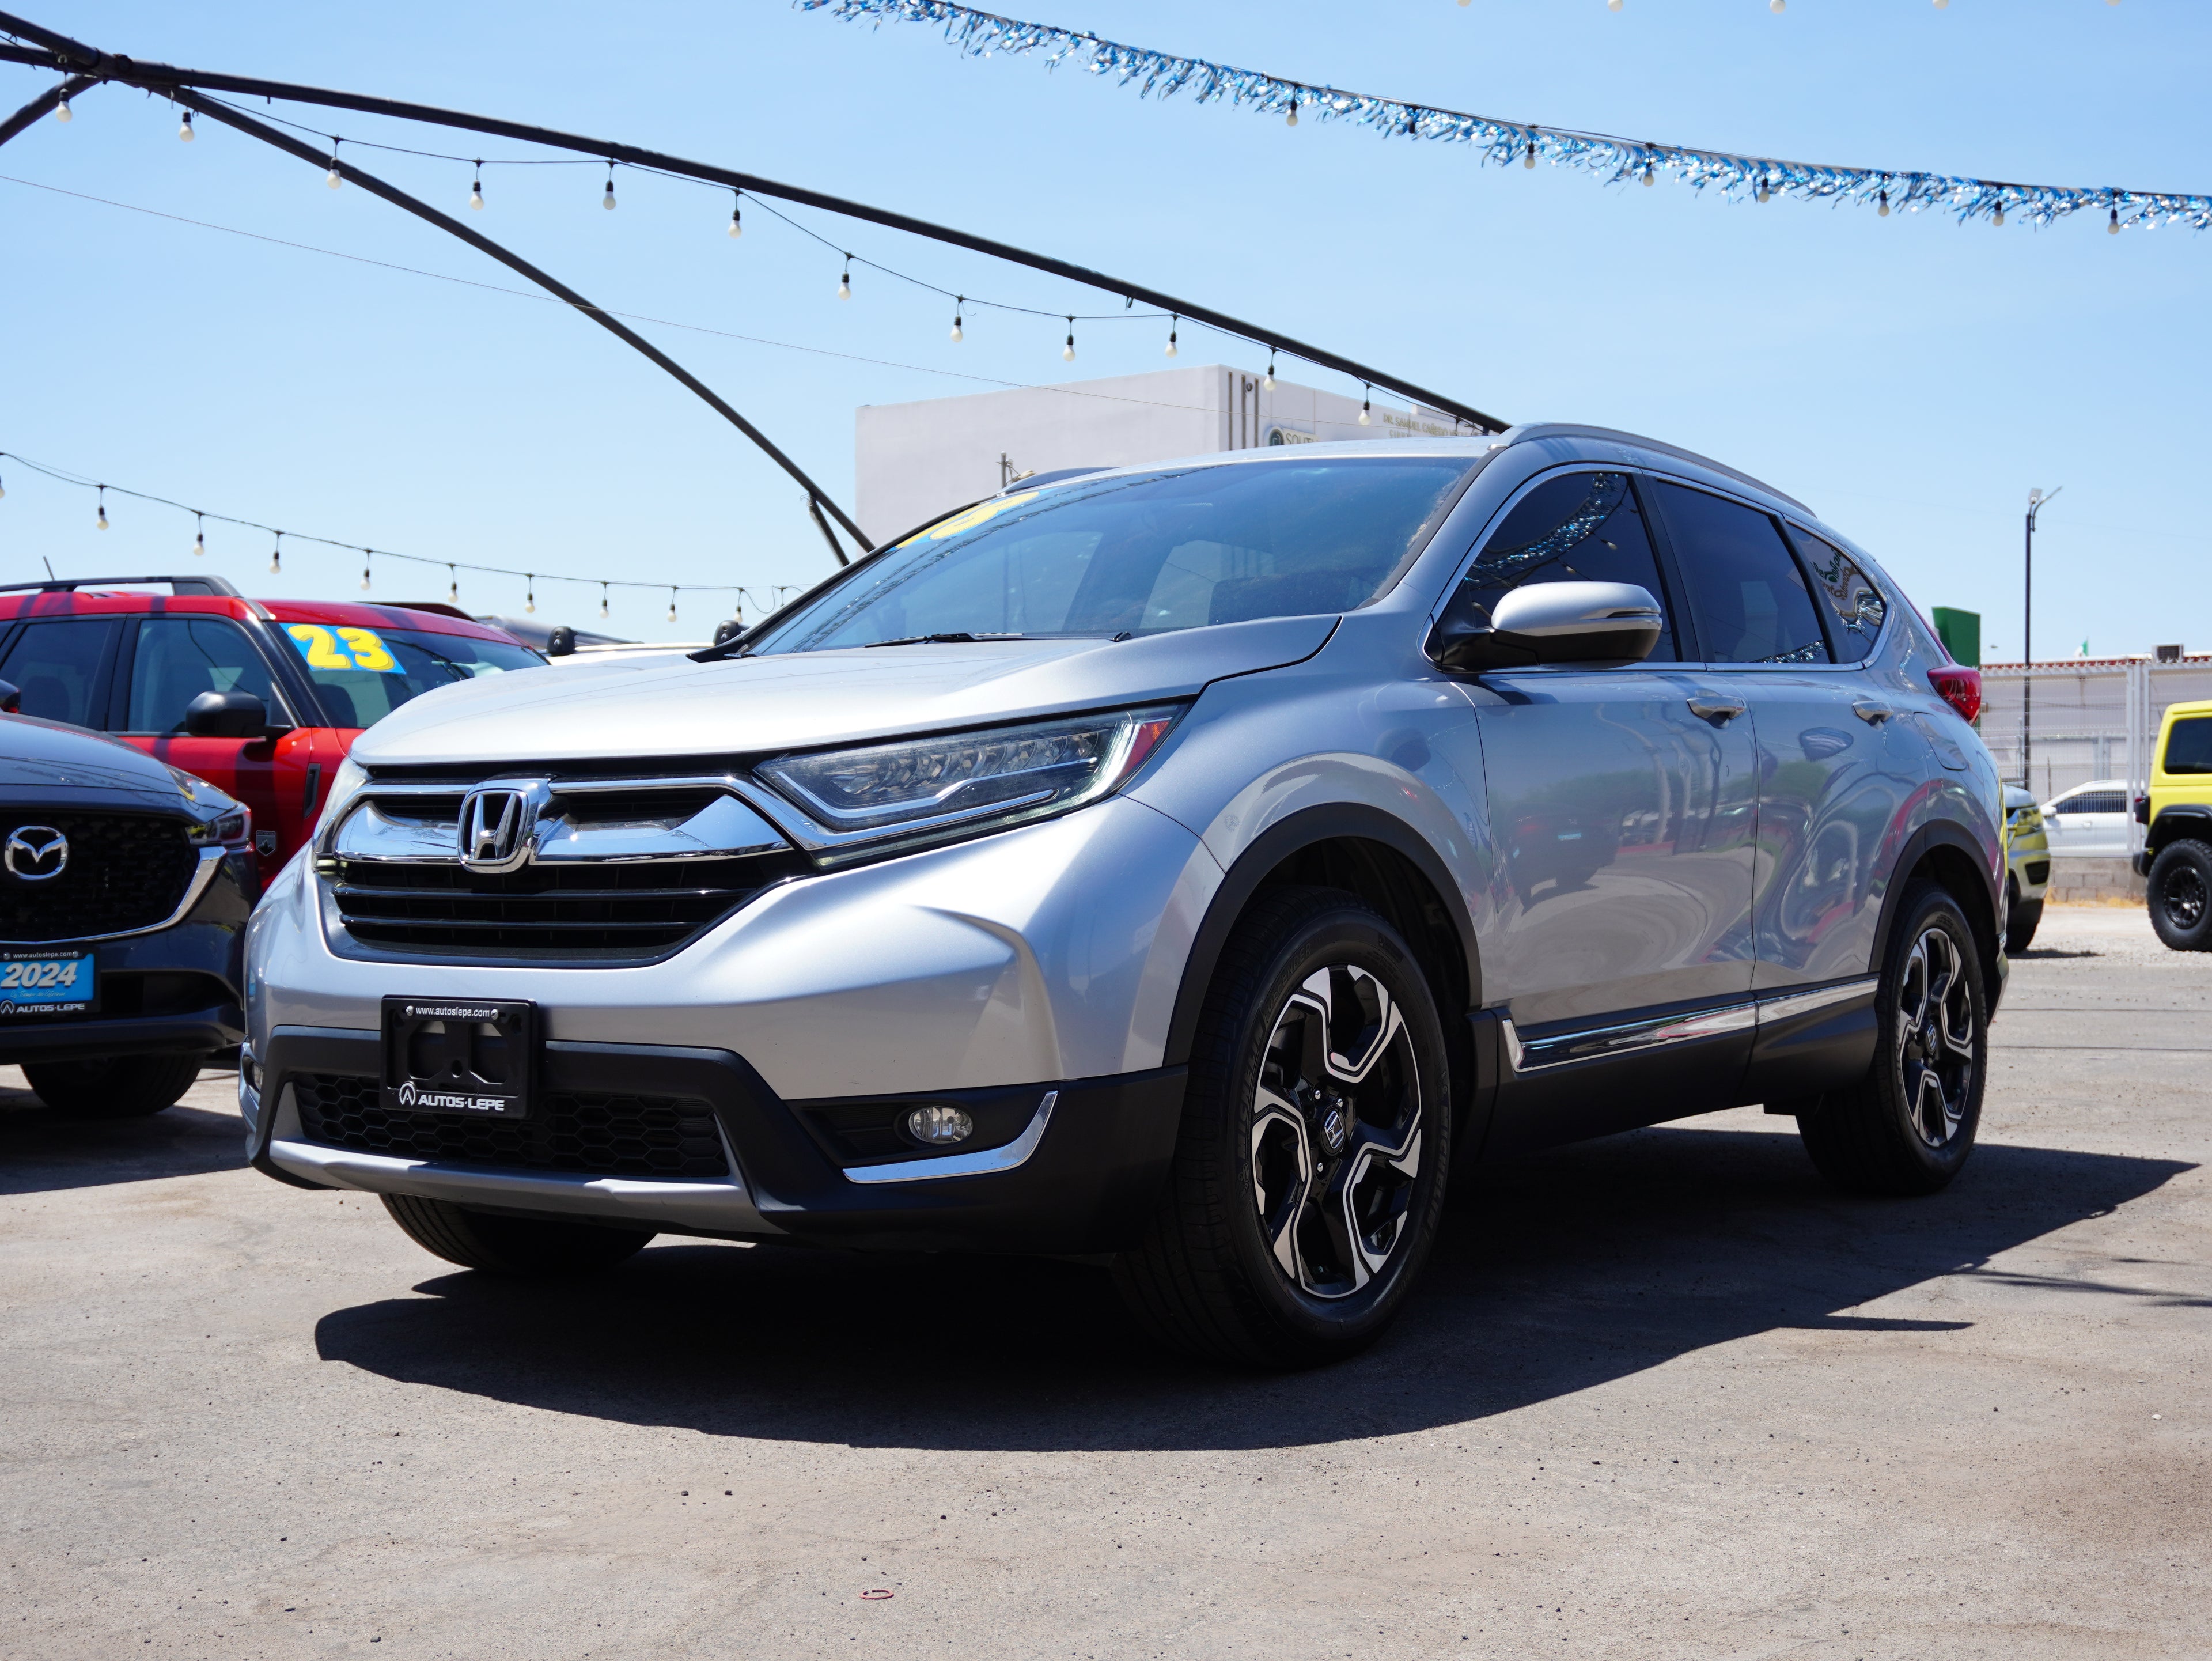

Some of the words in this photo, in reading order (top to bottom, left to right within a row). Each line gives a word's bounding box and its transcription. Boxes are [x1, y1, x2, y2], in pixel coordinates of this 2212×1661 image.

[1286, 433, 1319, 445] SOU
[287, 624, 395, 671] 23
[0, 962, 78, 988] 2024
[415, 1007, 490, 1018] www.autoslepe.com
[1237, 1010, 1265, 1160] MICHELIN
[1427, 1104, 1449, 1231] MICHELIN
